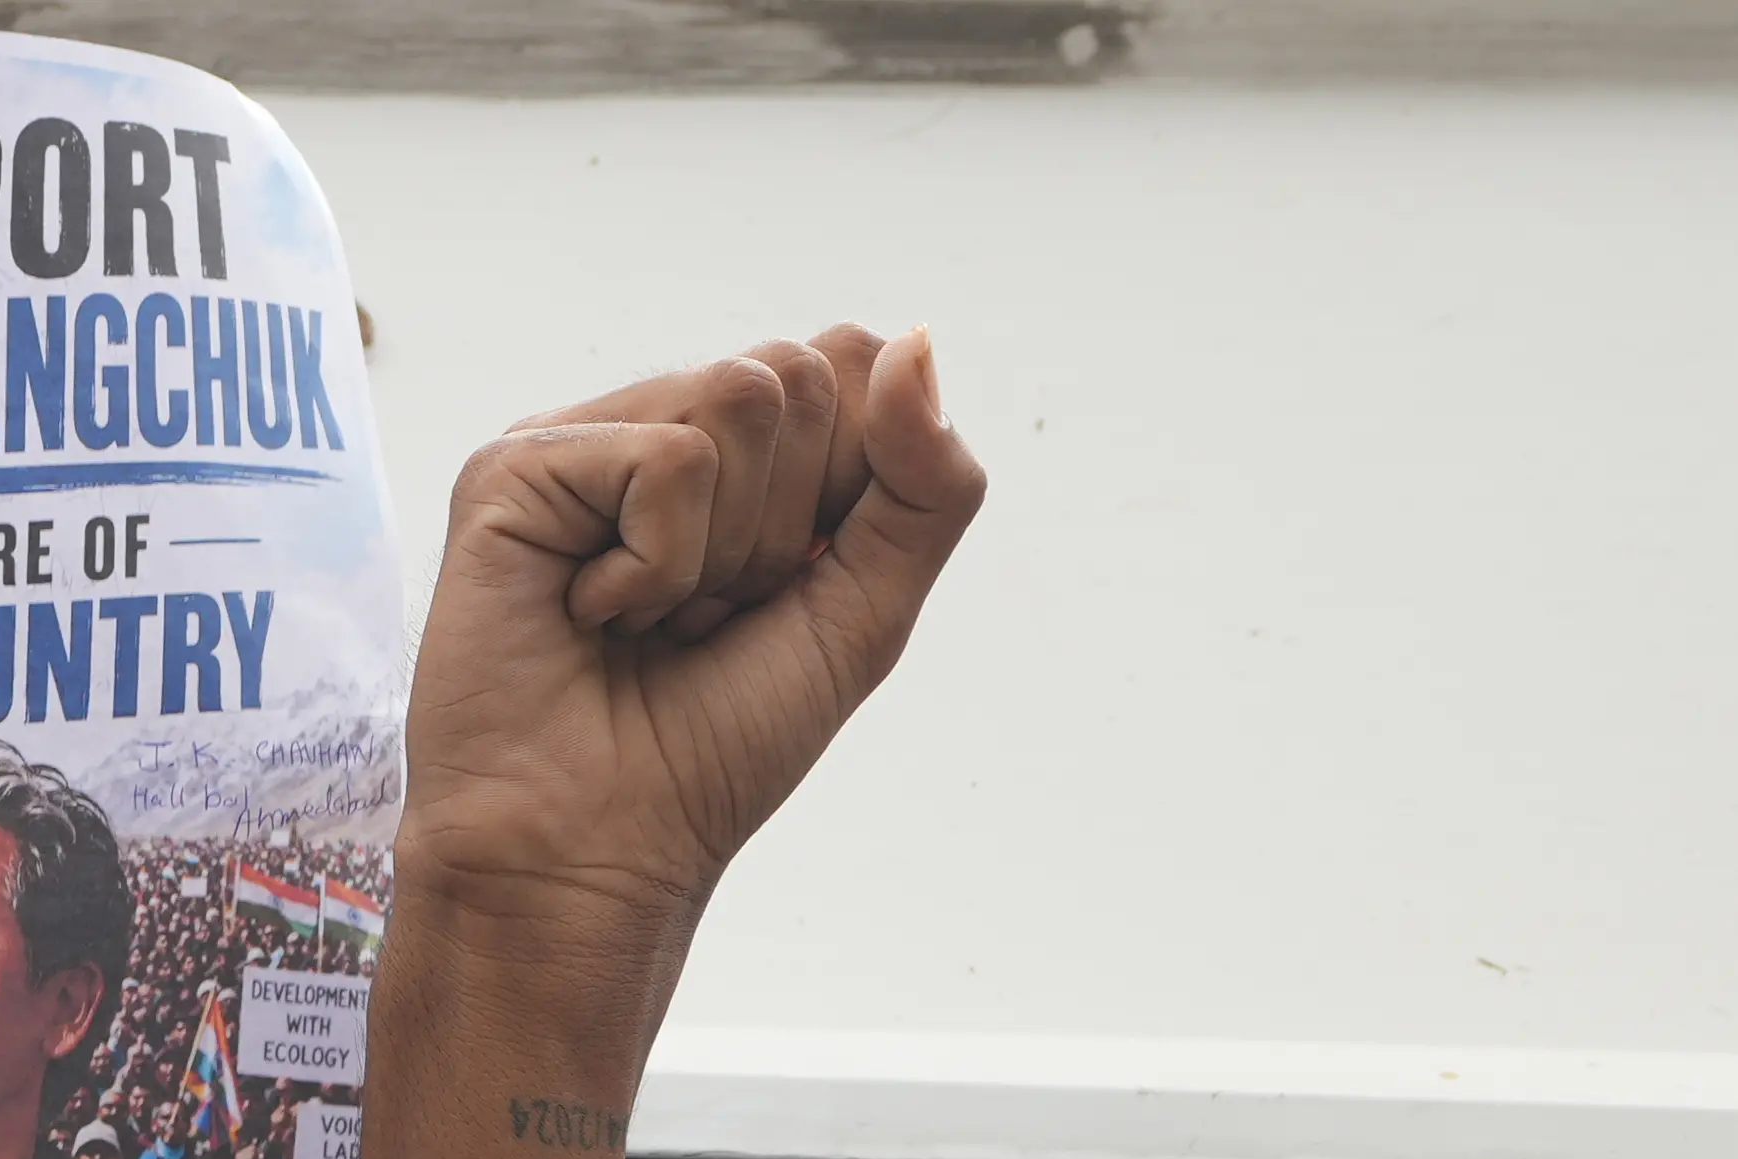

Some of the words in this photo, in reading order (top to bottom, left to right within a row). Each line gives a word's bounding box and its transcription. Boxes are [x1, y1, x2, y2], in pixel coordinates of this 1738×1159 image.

[84, 514, 151, 580] OF
[251, 979, 368, 1010] DEVELOPMENT
[286, 1014, 332, 1037] WITH
[263, 1041, 350, 1070] ECOLOGY
